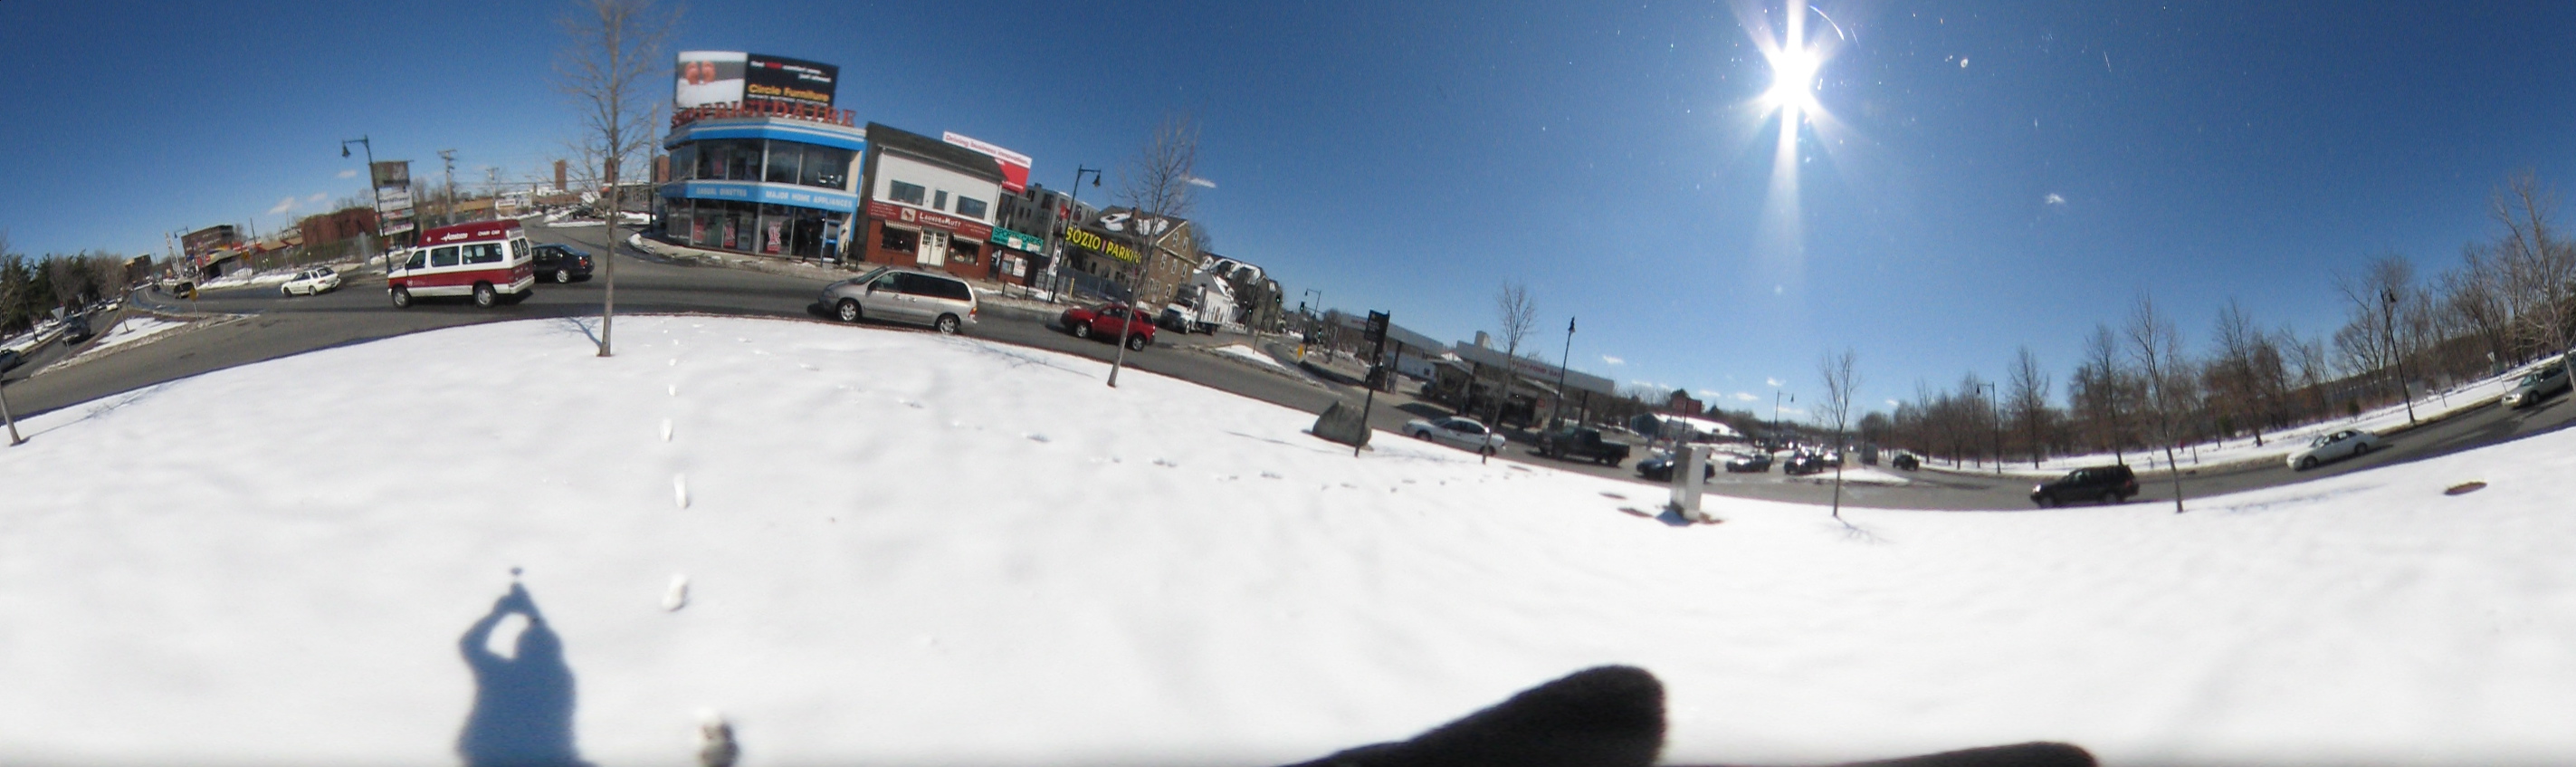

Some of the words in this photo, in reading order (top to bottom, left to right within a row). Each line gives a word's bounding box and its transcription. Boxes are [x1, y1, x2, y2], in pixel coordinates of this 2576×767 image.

[699, 101, 857, 128] FRIGIDAIRE
[945, 134, 969, 149] Driving
[971, 140, 997, 154] business
[766, 190, 788, 200] MAJOR
[792, 192, 811, 203] HOME
[813, 194, 853, 208] APPLIANCES
[1065, 226, 1102, 250] SOZIO
[1105, 241, 1143, 264] PARKIN
